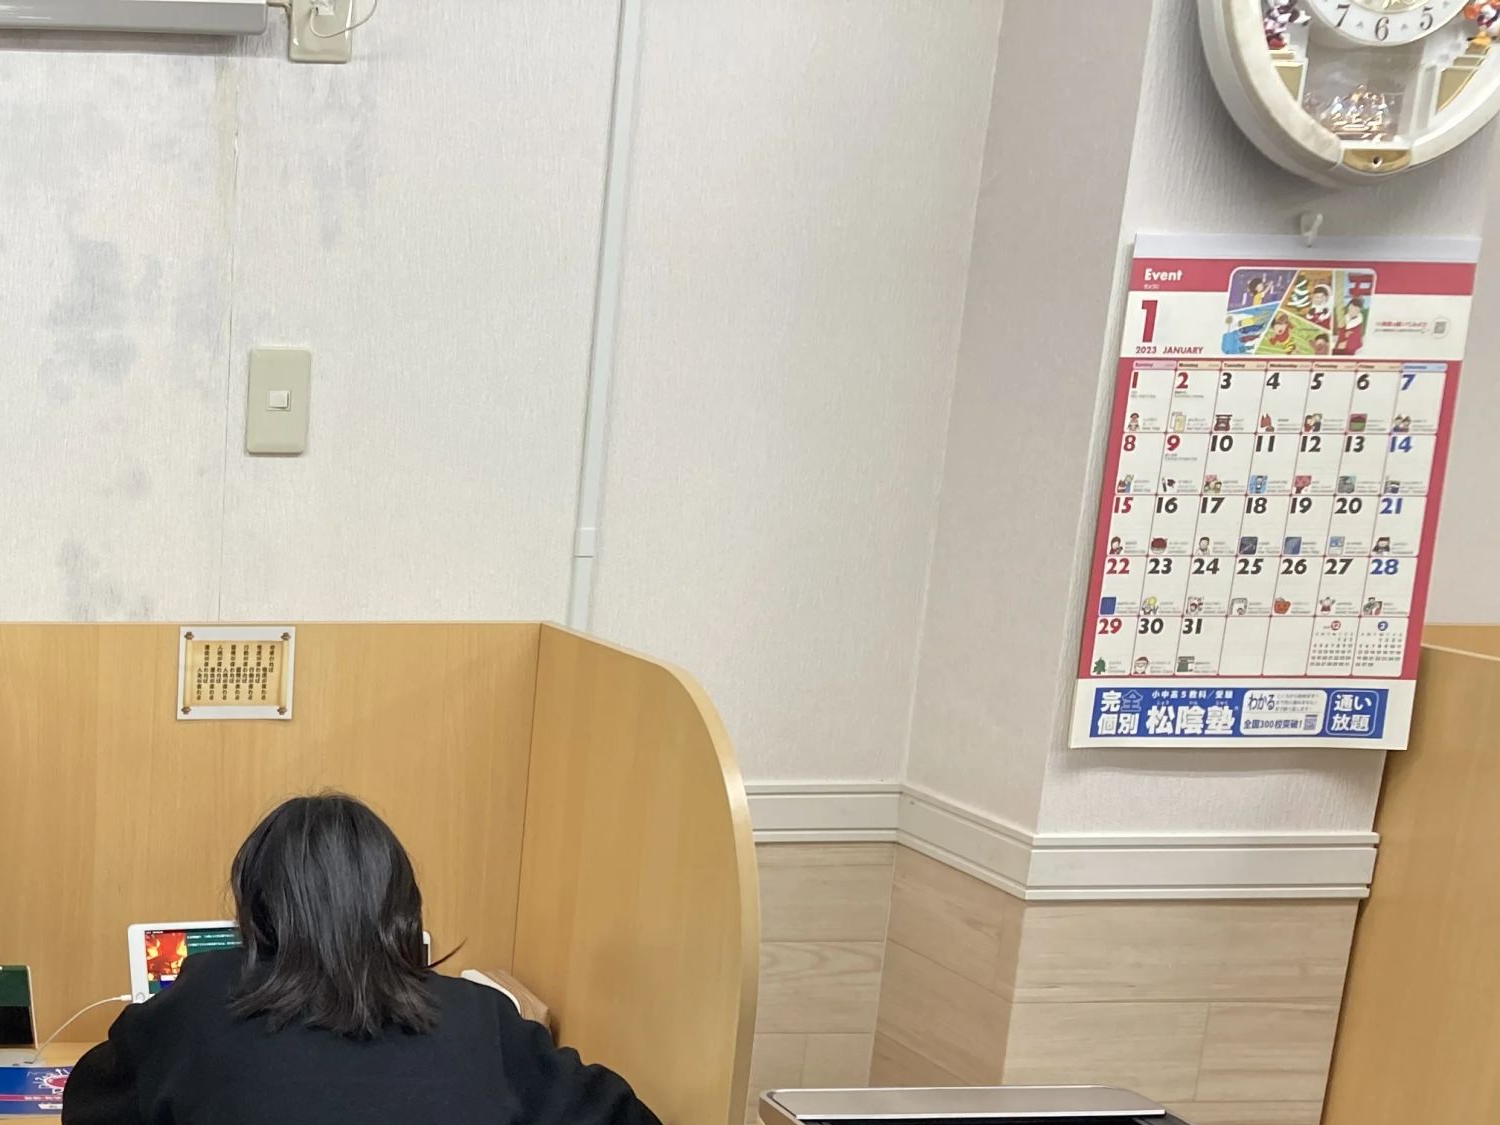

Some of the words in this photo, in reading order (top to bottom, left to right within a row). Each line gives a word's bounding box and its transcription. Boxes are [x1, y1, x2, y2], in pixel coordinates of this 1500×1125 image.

[1336, 4, 1350, 28] 7
[1375, 17, 1389, 40] 6
[1420, 7, 1434, 30] 5
[1144, 268, 1183, 280] Event
[1142, 300, 1158, 342] 1
[1136, 346, 1156, 354] 2023
[1132, 372, 1138, 388] 1
[1177, 372, 1188, 388] 2
[1221, 373, 1232, 389] 3
[1266, 373, 1280, 389] 4
[1311, 373, 1324, 390] 5
[1357, 374, 1369, 390] 6
[1402, 375, 1415, 390] 7
[1123, 436, 1135, 451] 8
[1167, 435, 1180, 451] 9
[1211, 435, 1233, 451] 10
[1256, 436, 1275, 452] 11
[1301, 436, 1320, 452] 12
[1345, 436, 1364, 452] 13
[1390, 437, 1411, 452] 14
[1113, 498, 1133, 513] 15
[1157, 497, 1177, 513] 16
[1201, 497, 1224, 513] 17
[1246, 498, 1267, 513] 18
[1290, 498, 1312, 513] 19
[1335, 498, 1362, 514] 20
[1381, 498, 1402, 514] 21
[1106, 558, 1129, 574] 22
[1148, 558, 1172, 574] 23
[1193, 558, 1219, 574] 24
[1237, 559, 1263, 574] 25
[1281, 559, 1307, 574] 26
[1325, 559, 1353, 574] 27
[1371, 559, 1398, 575] 28
[1098, 619, 1122, 634] 29
[1139, 618, 1163, 634] 30
[1183, 619, 1202, 634] 31
[1101, 690, 1143, 712] 完全
[1248, 694, 1275, 711] わかる
[1334, 694, 1371, 711] 通い
[1098, 713, 1139, 735] 個別
[1146, 705, 1235, 735] 松陰塾
[1331, 714, 1371, 731] 放題
